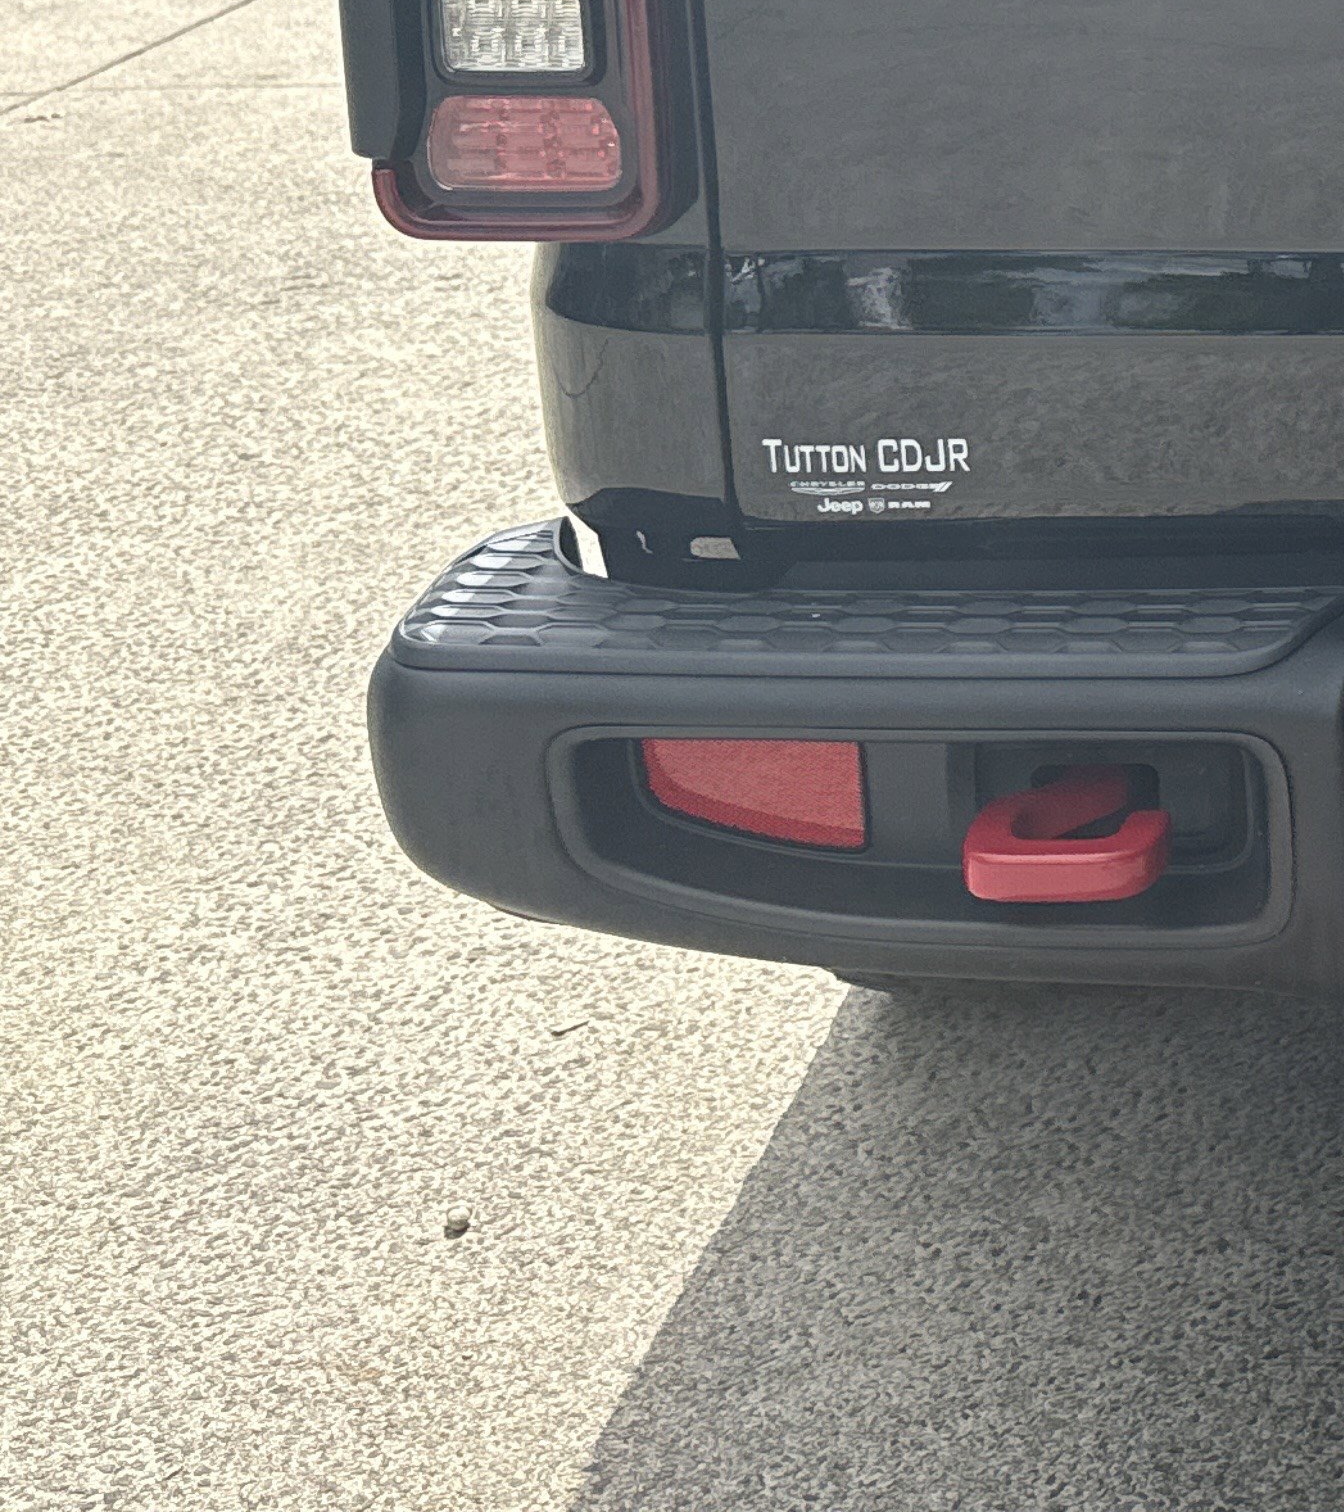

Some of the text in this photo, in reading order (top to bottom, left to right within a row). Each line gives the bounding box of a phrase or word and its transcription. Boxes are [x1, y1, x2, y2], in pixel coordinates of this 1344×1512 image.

[877, 438, 971, 473] CDJR
[790, 480, 866, 488] CHRYSLER
[816, 497, 864, 515] Jeep
[887, 500, 931, 509] RAM
